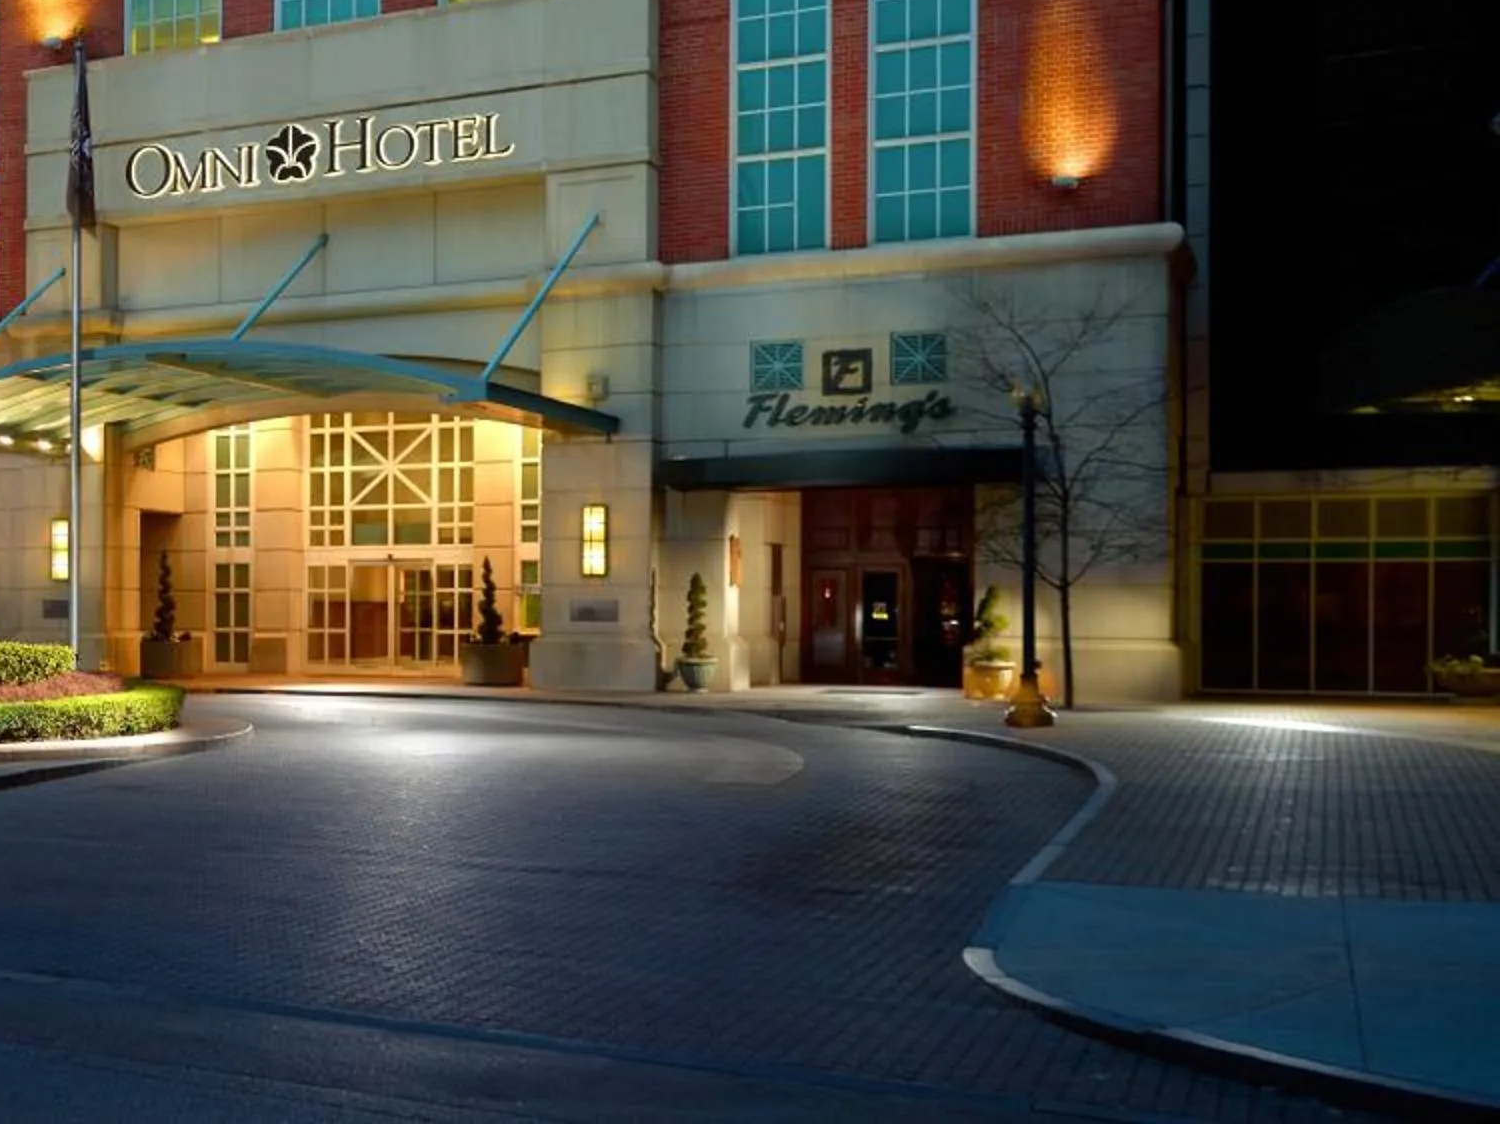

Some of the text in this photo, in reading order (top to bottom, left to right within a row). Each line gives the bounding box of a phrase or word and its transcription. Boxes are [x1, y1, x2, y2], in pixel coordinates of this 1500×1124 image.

[125, 113, 515, 199] OMNI HOTEL
[742, 389, 956, 434] Fleming's
